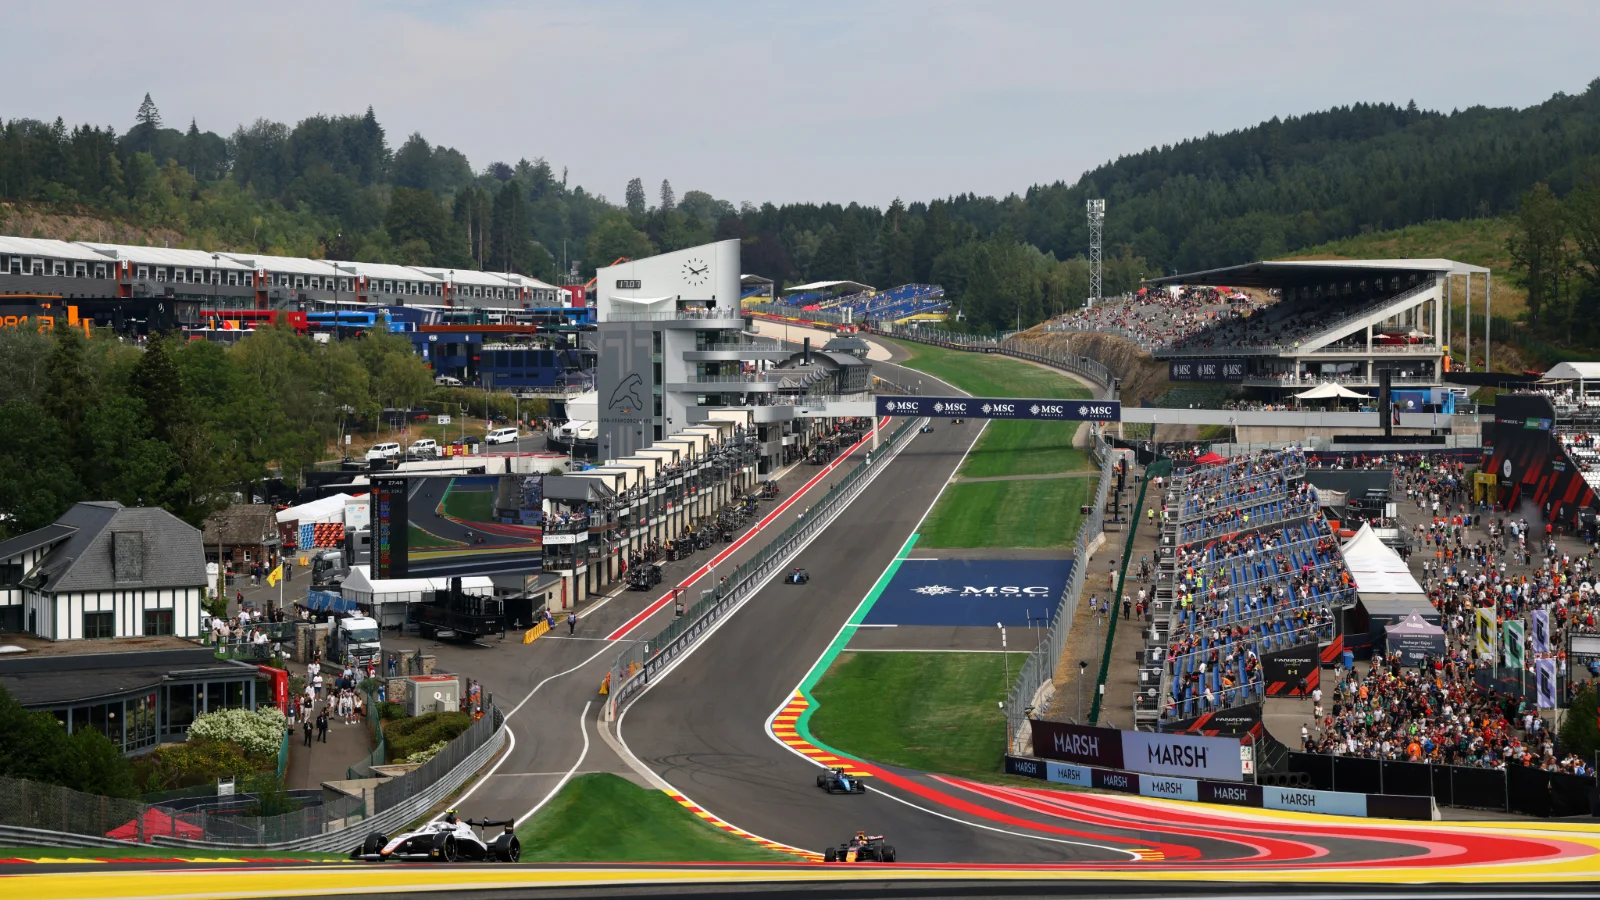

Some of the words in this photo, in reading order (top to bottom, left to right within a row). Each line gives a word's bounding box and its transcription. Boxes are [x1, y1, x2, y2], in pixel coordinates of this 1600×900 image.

[1179, 364, 1190, 374] MSC
[1204, 364, 1216, 374] MSC
[1229, 364, 1242, 374] MSC
[897, 402, 918, 410] MSC
[945, 403, 966, 411] MSC
[993, 404, 1014, 412] MSC
[962, 586, 1049, 594] MSC
[1054, 732, 1099, 757] MARSH
[1148, 743, 1207, 768] MARSH
[1015, 762, 1036, 774] MARSH
[1057, 768, 1080, 780] MARSH
[1103, 775, 1127, 788] MARSH
[1152, 781, 1182, 794] MARSH
[1214, 787, 1246, 800] MARSH
[1281, 792, 1315, 806] MARSH
